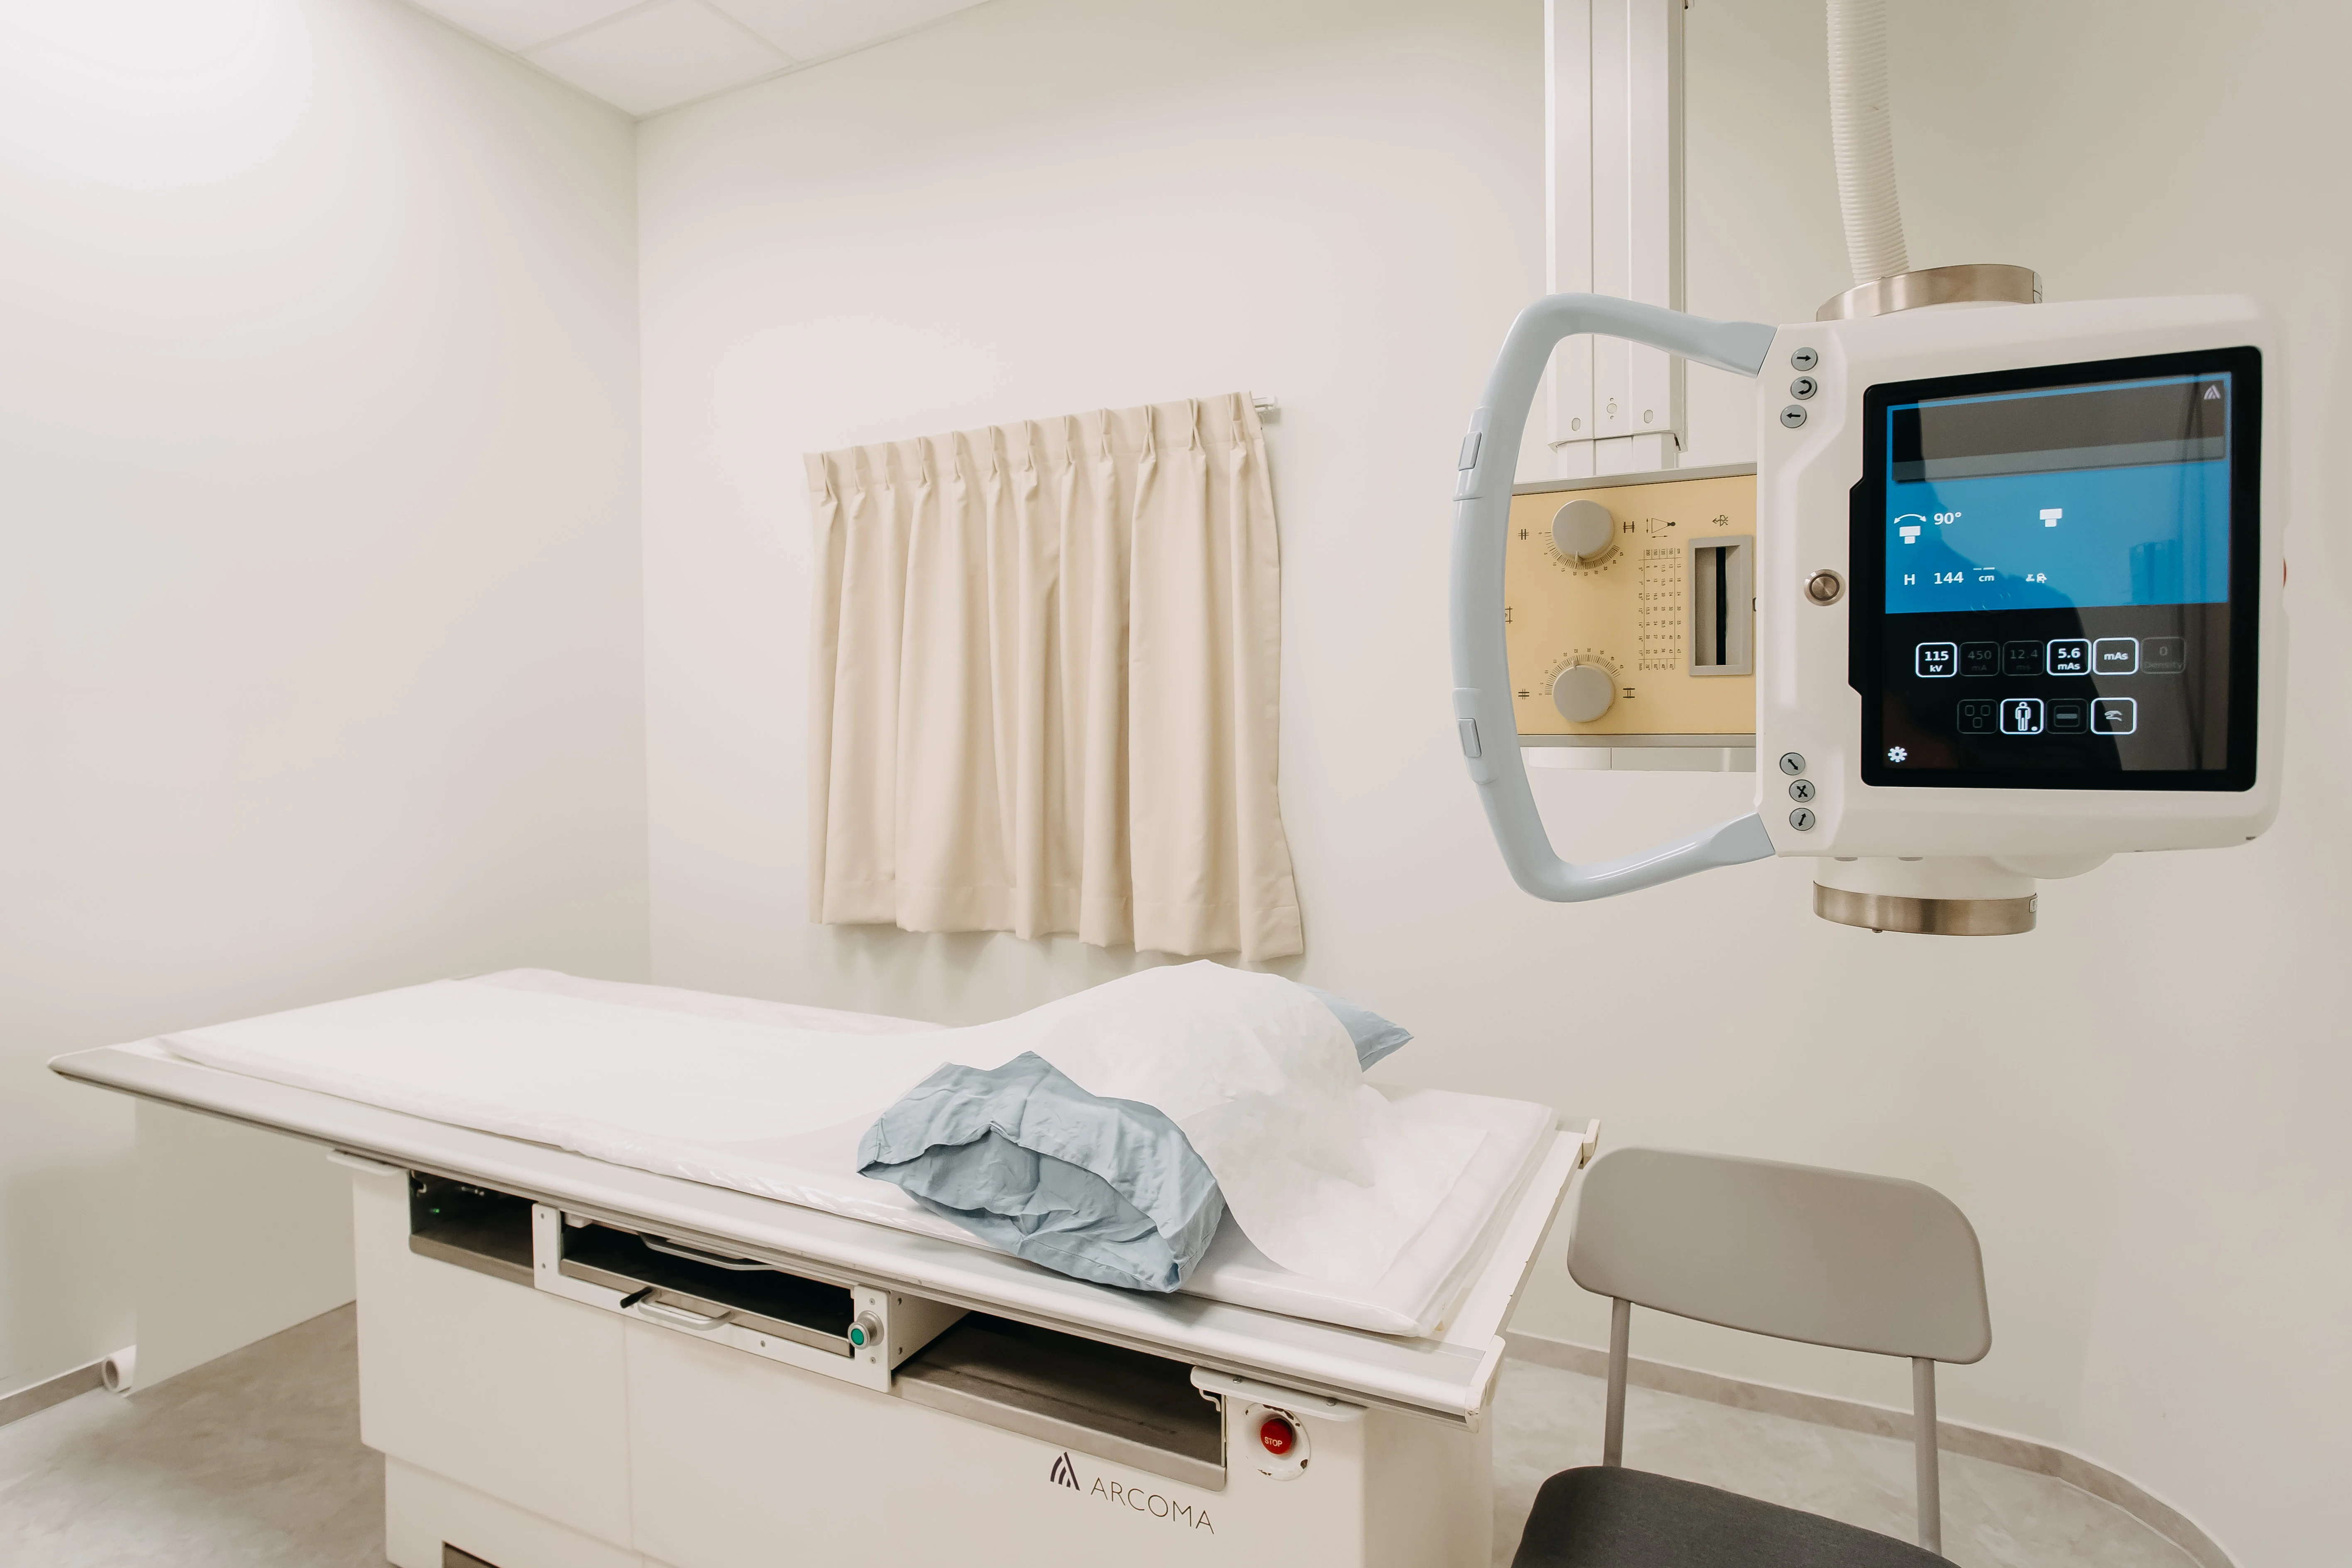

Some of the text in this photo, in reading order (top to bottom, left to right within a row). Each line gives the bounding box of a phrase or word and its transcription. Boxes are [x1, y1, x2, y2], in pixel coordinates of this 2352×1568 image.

[1933, 511, 1962, 526] 90°
[1904, 573, 1916, 586] H
[1934, 571, 1964, 585] 144
[1924, 651, 1949, 661] 115
[1968, 650, 1992, 660] 450
[2010, 649, 2038, 659] 12.4
[2058, 648, 2081, 658] 5.6
[2103, 651, 2129, 660] mAs
[1264, 1436, 1283, 1447] STOP
[1090, 1477, 1215, 1535] ARCOMA
